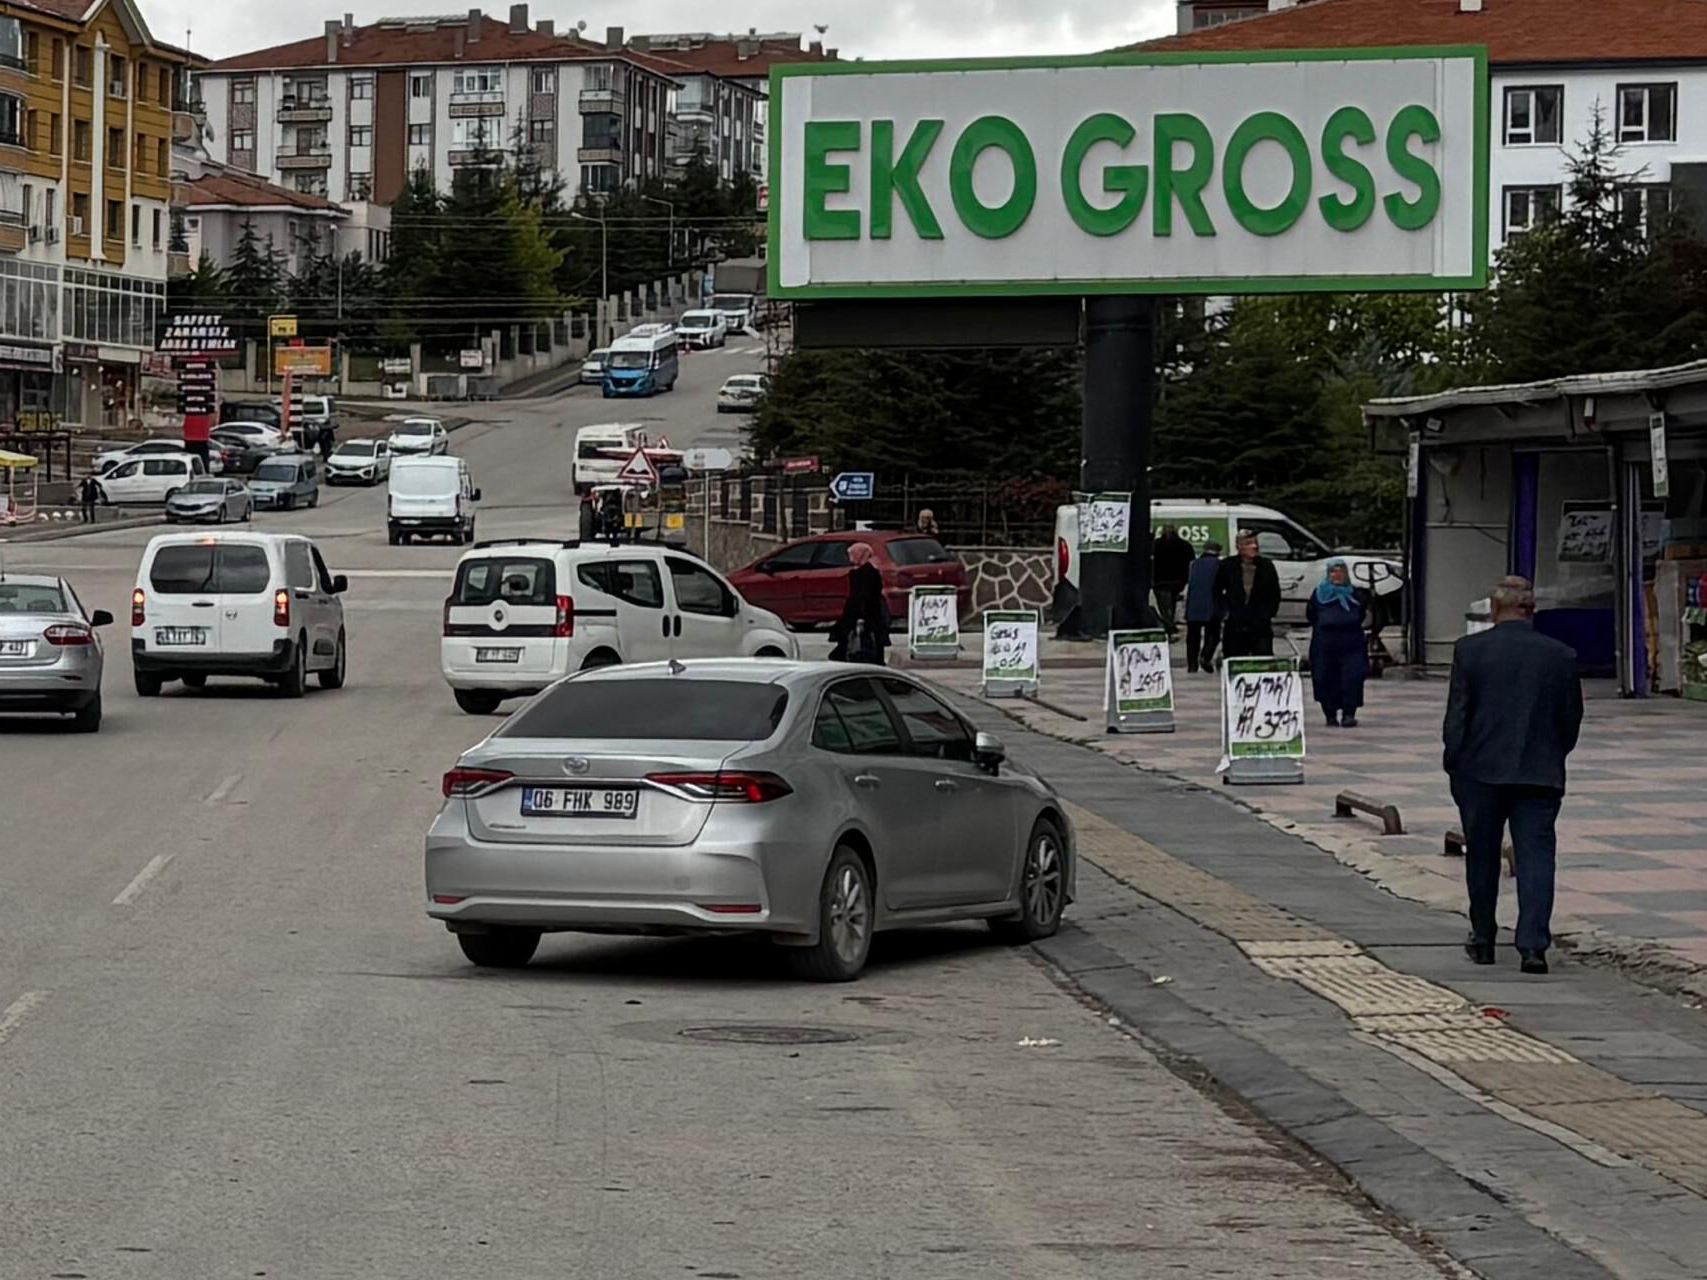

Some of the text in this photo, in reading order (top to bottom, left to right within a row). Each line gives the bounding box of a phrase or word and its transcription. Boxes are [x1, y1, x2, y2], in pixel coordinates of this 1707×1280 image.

[803, 104, 1442, 241] EKO GROSS
[533, 790, 634, 811] 06 FHK 989
